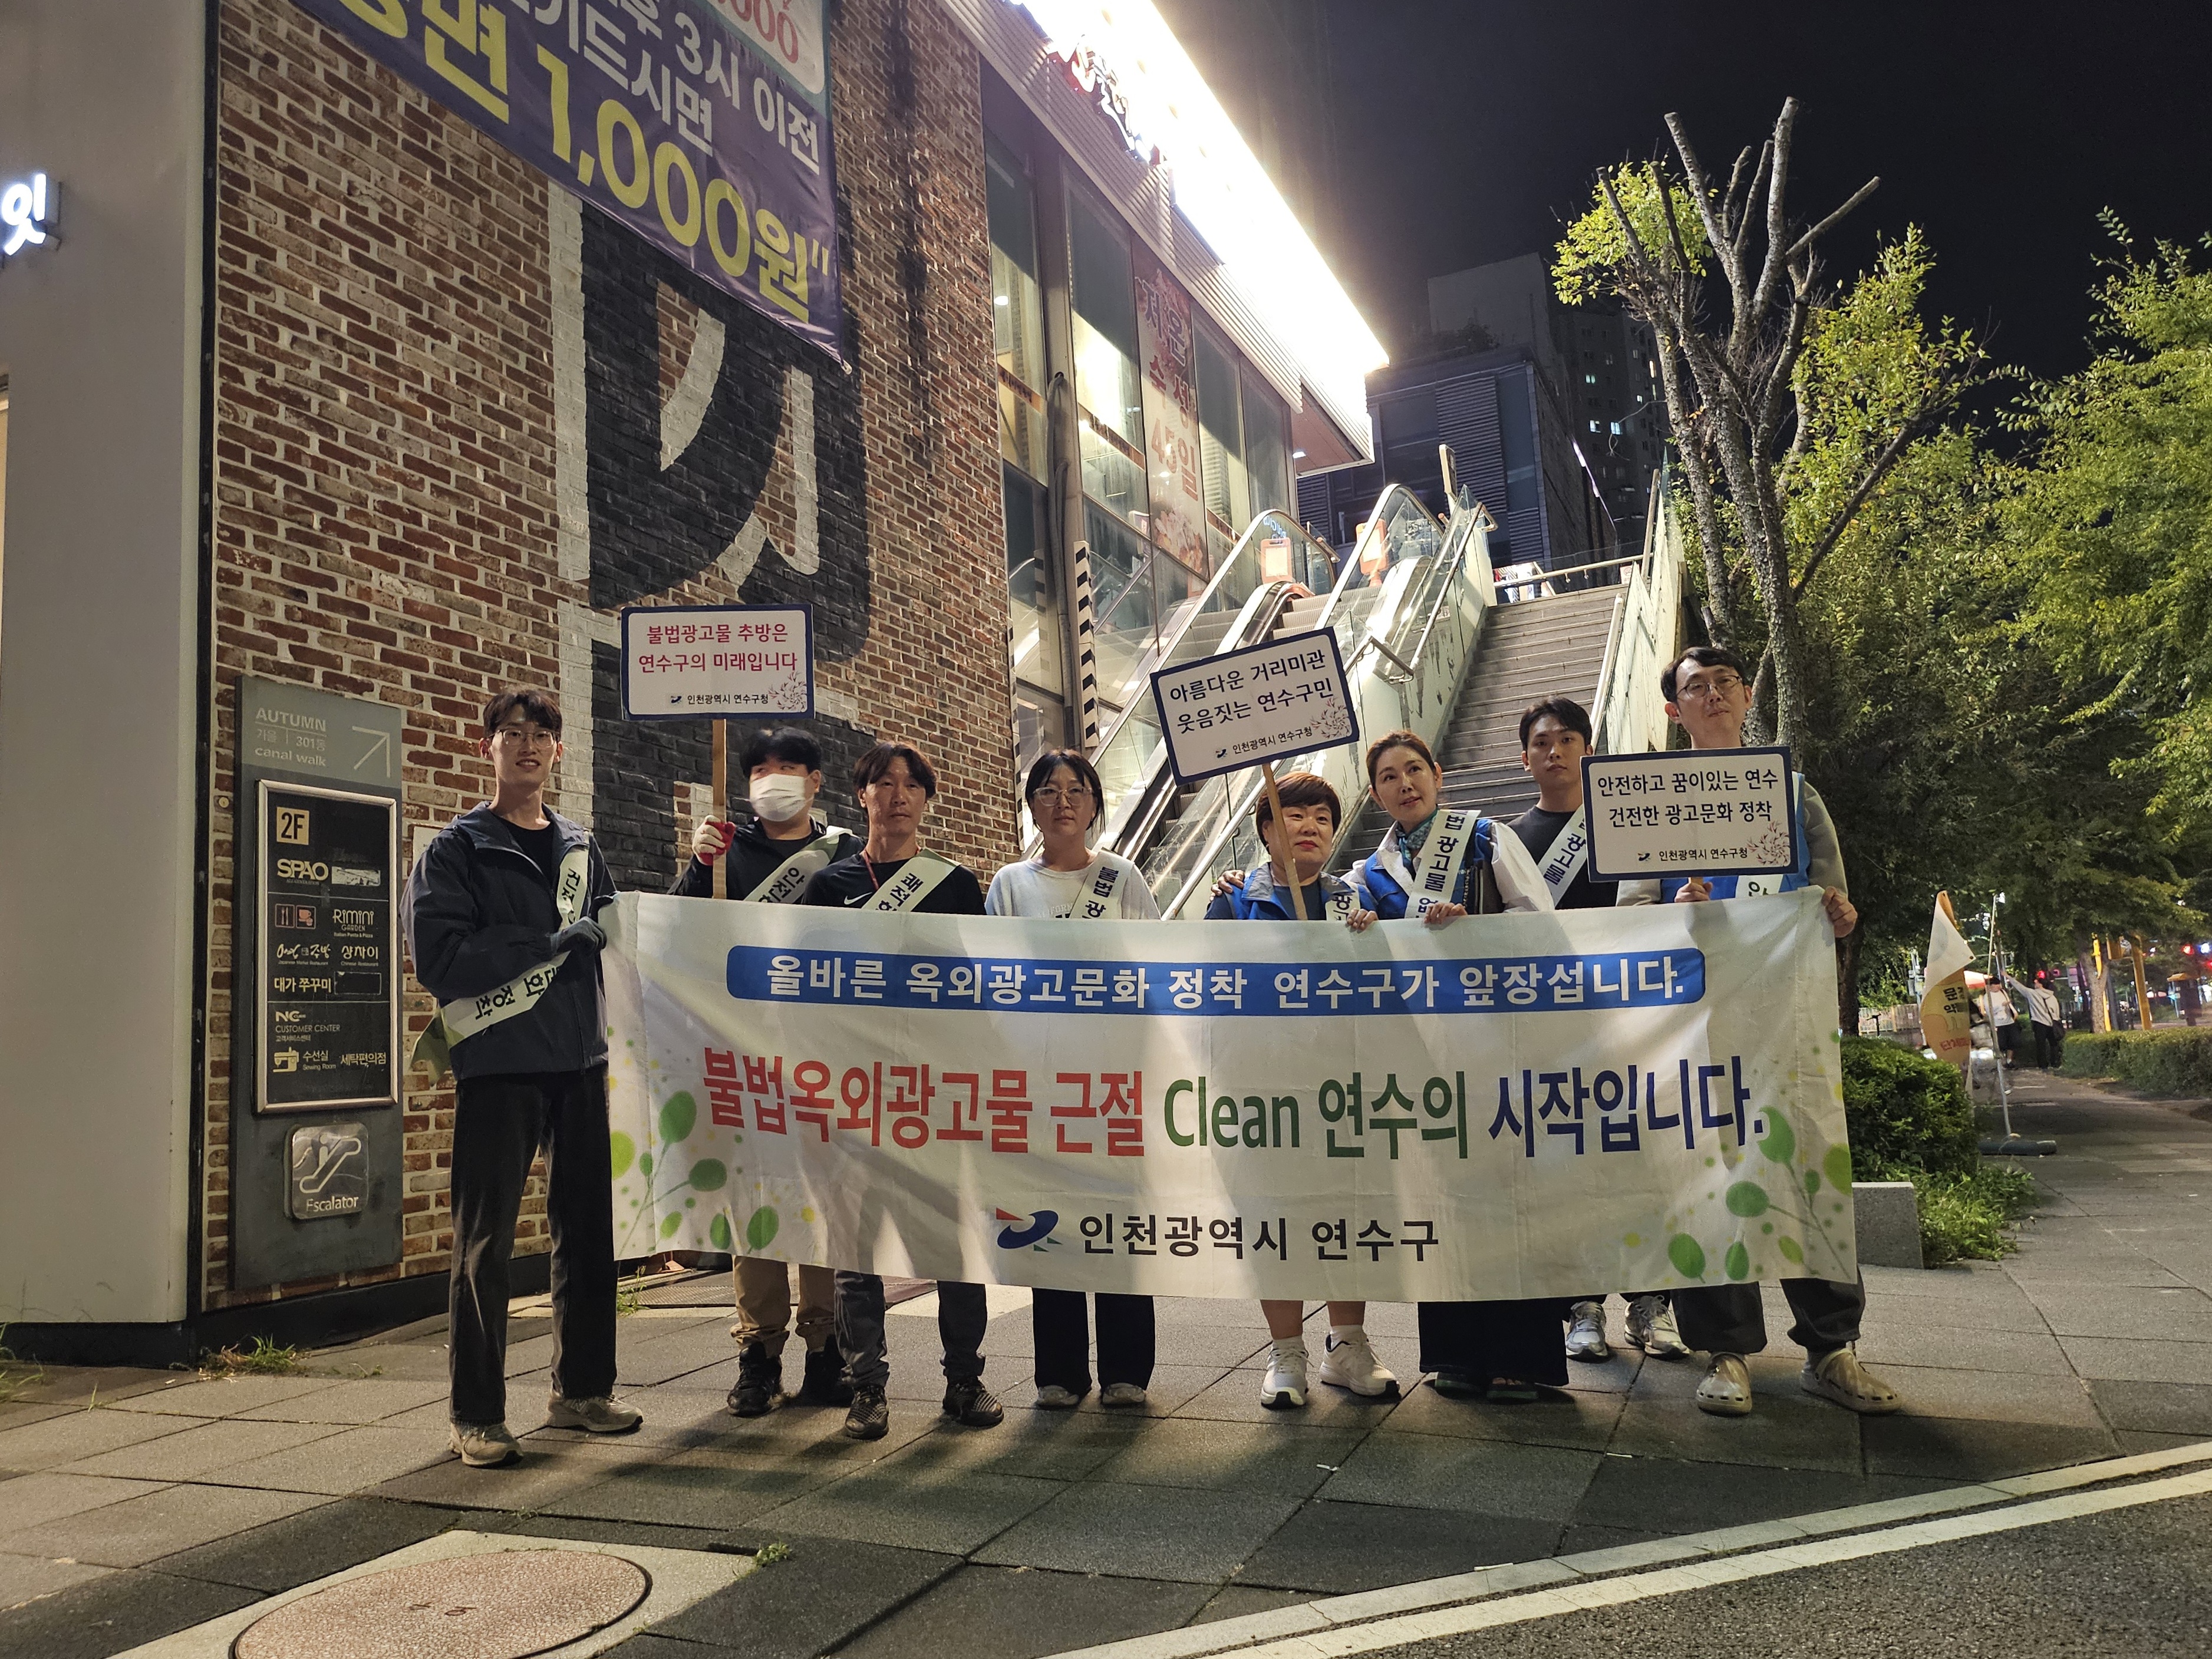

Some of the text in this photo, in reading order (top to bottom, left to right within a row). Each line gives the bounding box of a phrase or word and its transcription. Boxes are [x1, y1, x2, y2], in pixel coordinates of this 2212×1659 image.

[674, 12, 740, 110] 3시
[754, 78, 819, 176] 이전
[1, 173, 47, 256] 잇
[1151, 417, 1199, 502] 45일
[647, 624, 788, 645] 불법광고물 추방은
[638, 652, 797, 673] 연수구의 미래입니다
[1170, 649, 1326, 703] 아름다운 거리미관
[687, 694, 769, 705] 인천광역시 연수구청
[1177, 678, 1334, 734] 웃음짓는 연수구민
[256, 707, 326, 732] AUTUMN
[296, 736, 325, 751] 301동
[1232, 726, 1313, 755] 인천광역시 연수구청
[255, 748, 327, 767] canal walk
[1597, 769, 1779, 797] 안전하고 꿈이있는 연수
[281, 812, 305, 840] 2F
[1608, 805, 1659, 828] 건전한
[1665, 802, 1733, 826] 광고문화
[1739, 800, 1773, 823] 정착
[1659, 847, 1748, 862] 인천광역시 연수구청
[277, 858, 329, 880] SPAO
[274, 977, 331, 993] 대가 쭈꾸미
[767, 955, 1683, 1010] 올바른 옥외광고문화 정착 연수구가 앞장섭니다.
[275, 1025, 312, 1033] CUSTOMER
[303, 1050, 387, 1067] 수선실 세탁편의점
[704, 1047, 1763, 1159] 불법옥외광고물 근절 Clean 연수의 시작입니다.
[306, 1196, 359, 1212] Escalator
[1079, 1213, 1439, 1261] 인천광역시 연수구
